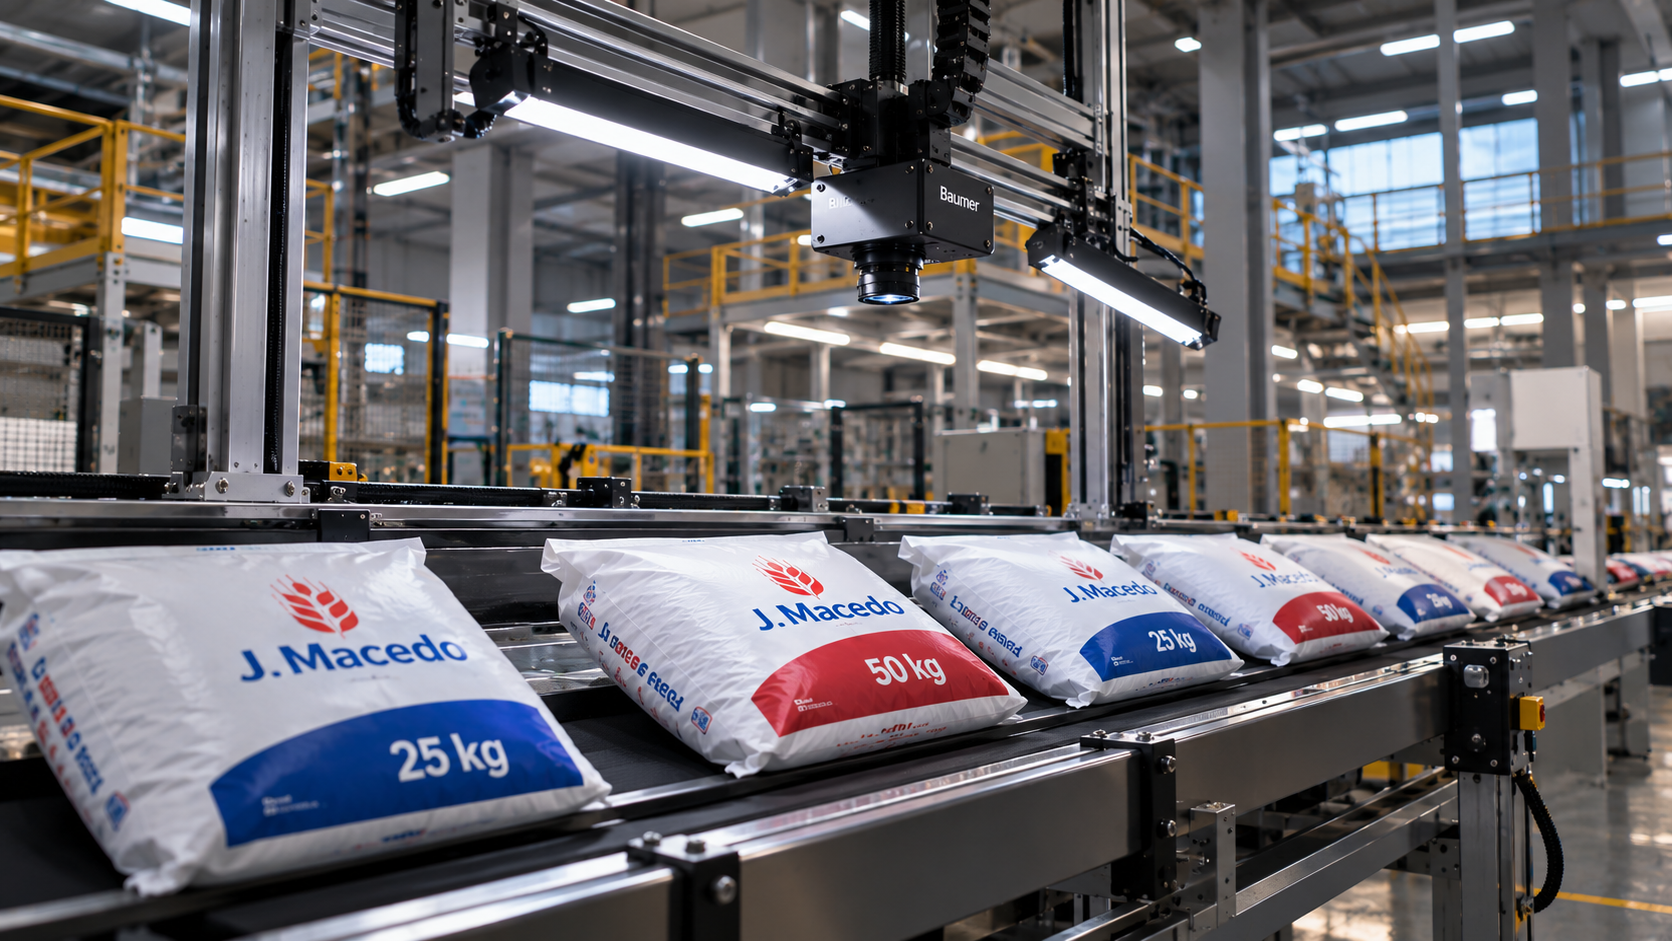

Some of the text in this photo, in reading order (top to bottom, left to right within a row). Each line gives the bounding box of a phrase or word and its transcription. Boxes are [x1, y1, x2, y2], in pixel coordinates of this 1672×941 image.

[940, 185, 980, 212] Baumer
[1316, 603, 1339, 622] 50
[1148, 628, 1197, 653] 25 kg
[864, 653, 947, 686] 50 kg
[389, 732, 510, 783] 25 kg
